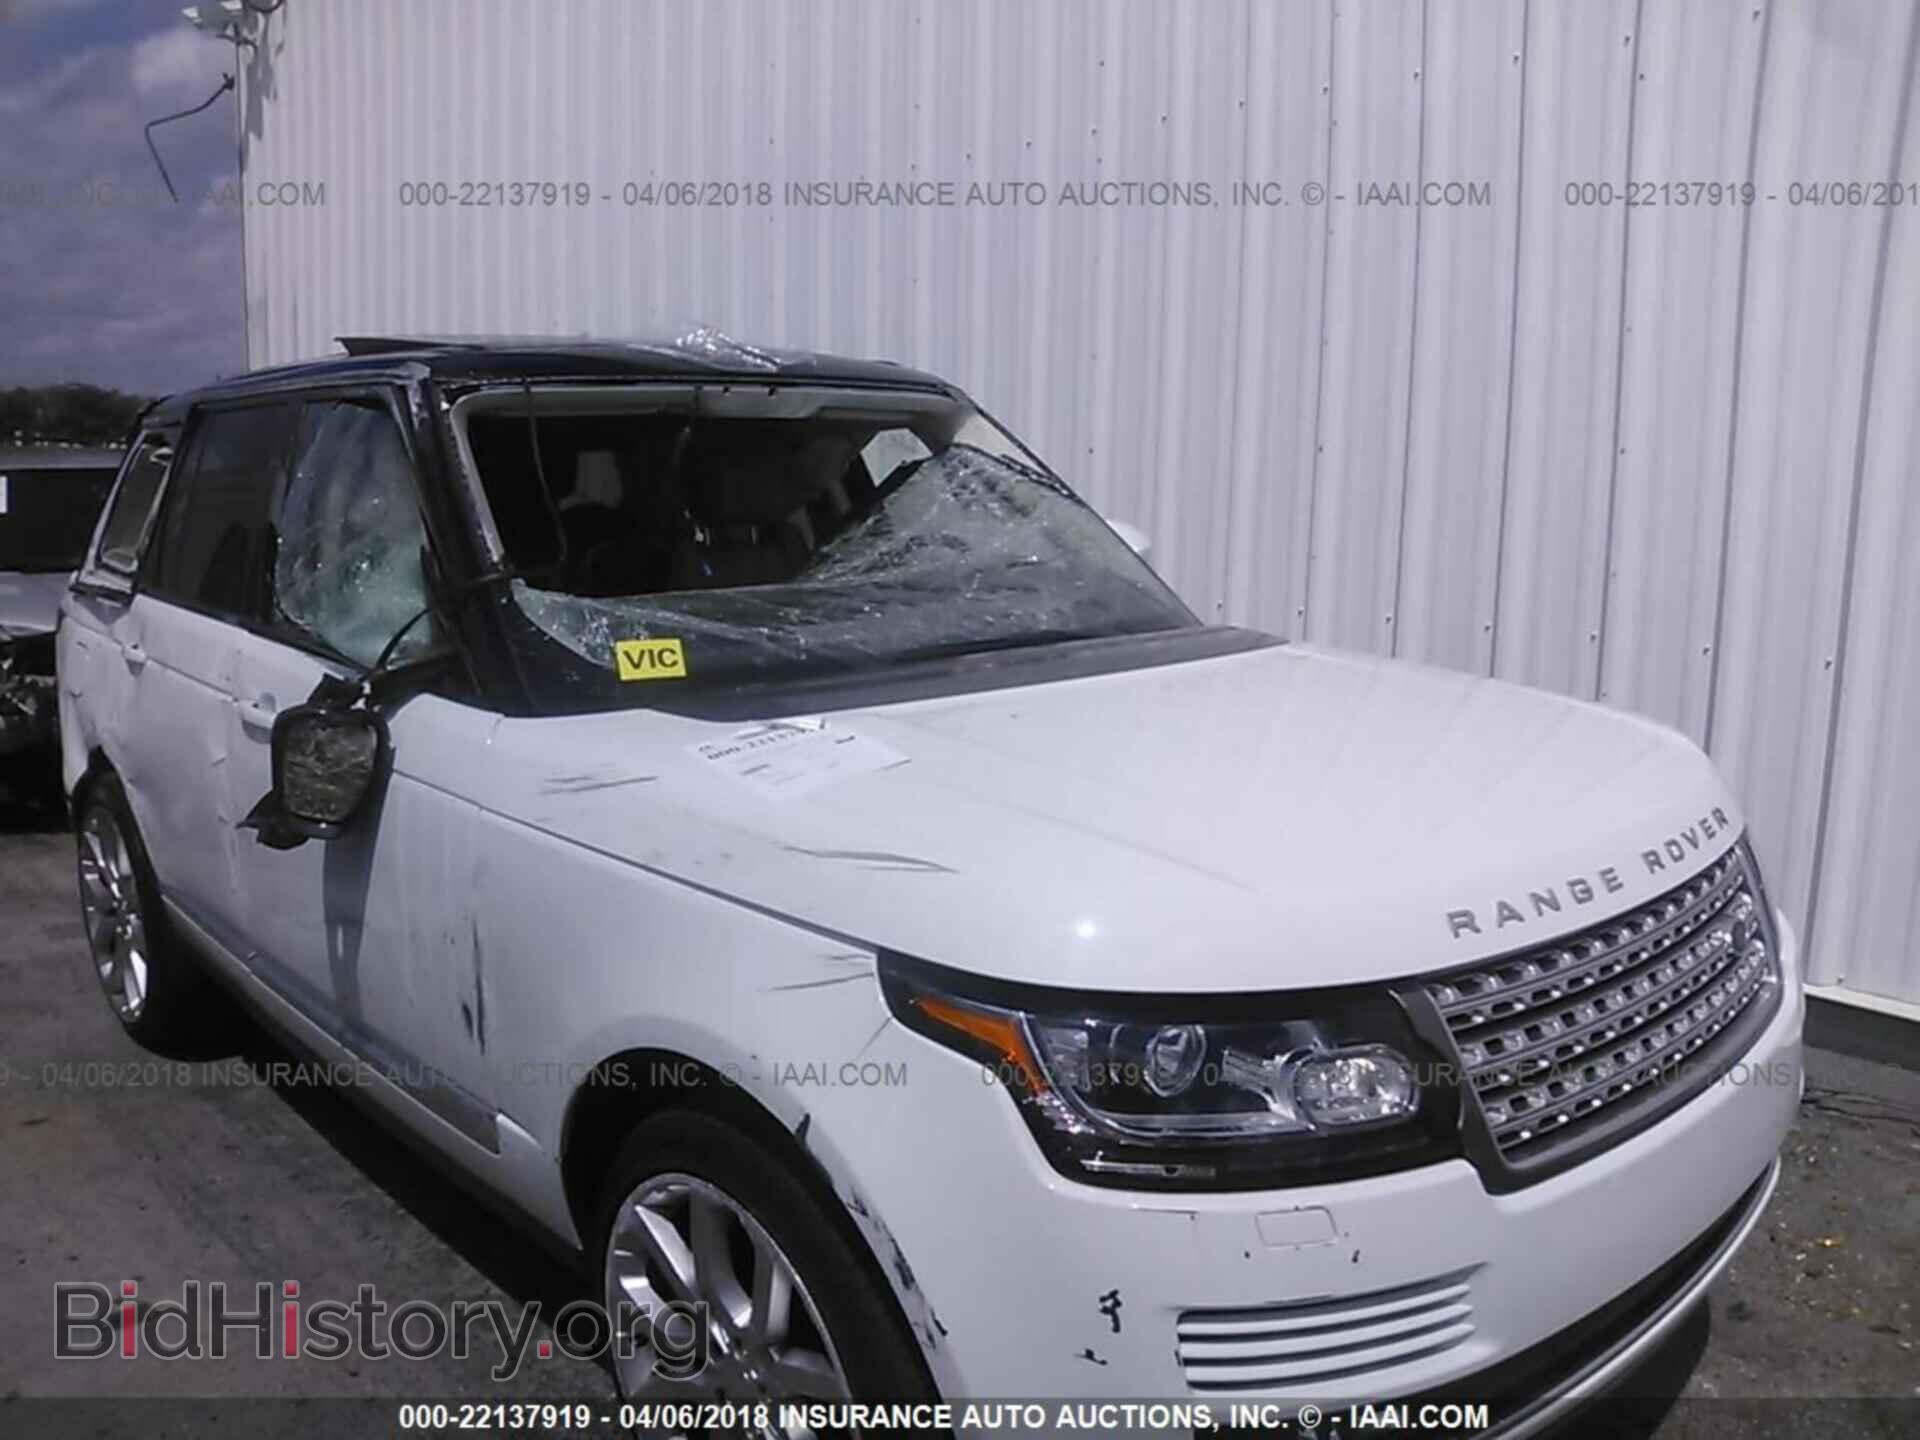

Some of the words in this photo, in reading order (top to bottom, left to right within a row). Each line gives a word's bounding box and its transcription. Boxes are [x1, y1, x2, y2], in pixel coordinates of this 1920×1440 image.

[623, 648, 679, 669] VIC
[1446, 867, 1624, 938] RANGE
[1641, 806, 1729, 874] ROVER
